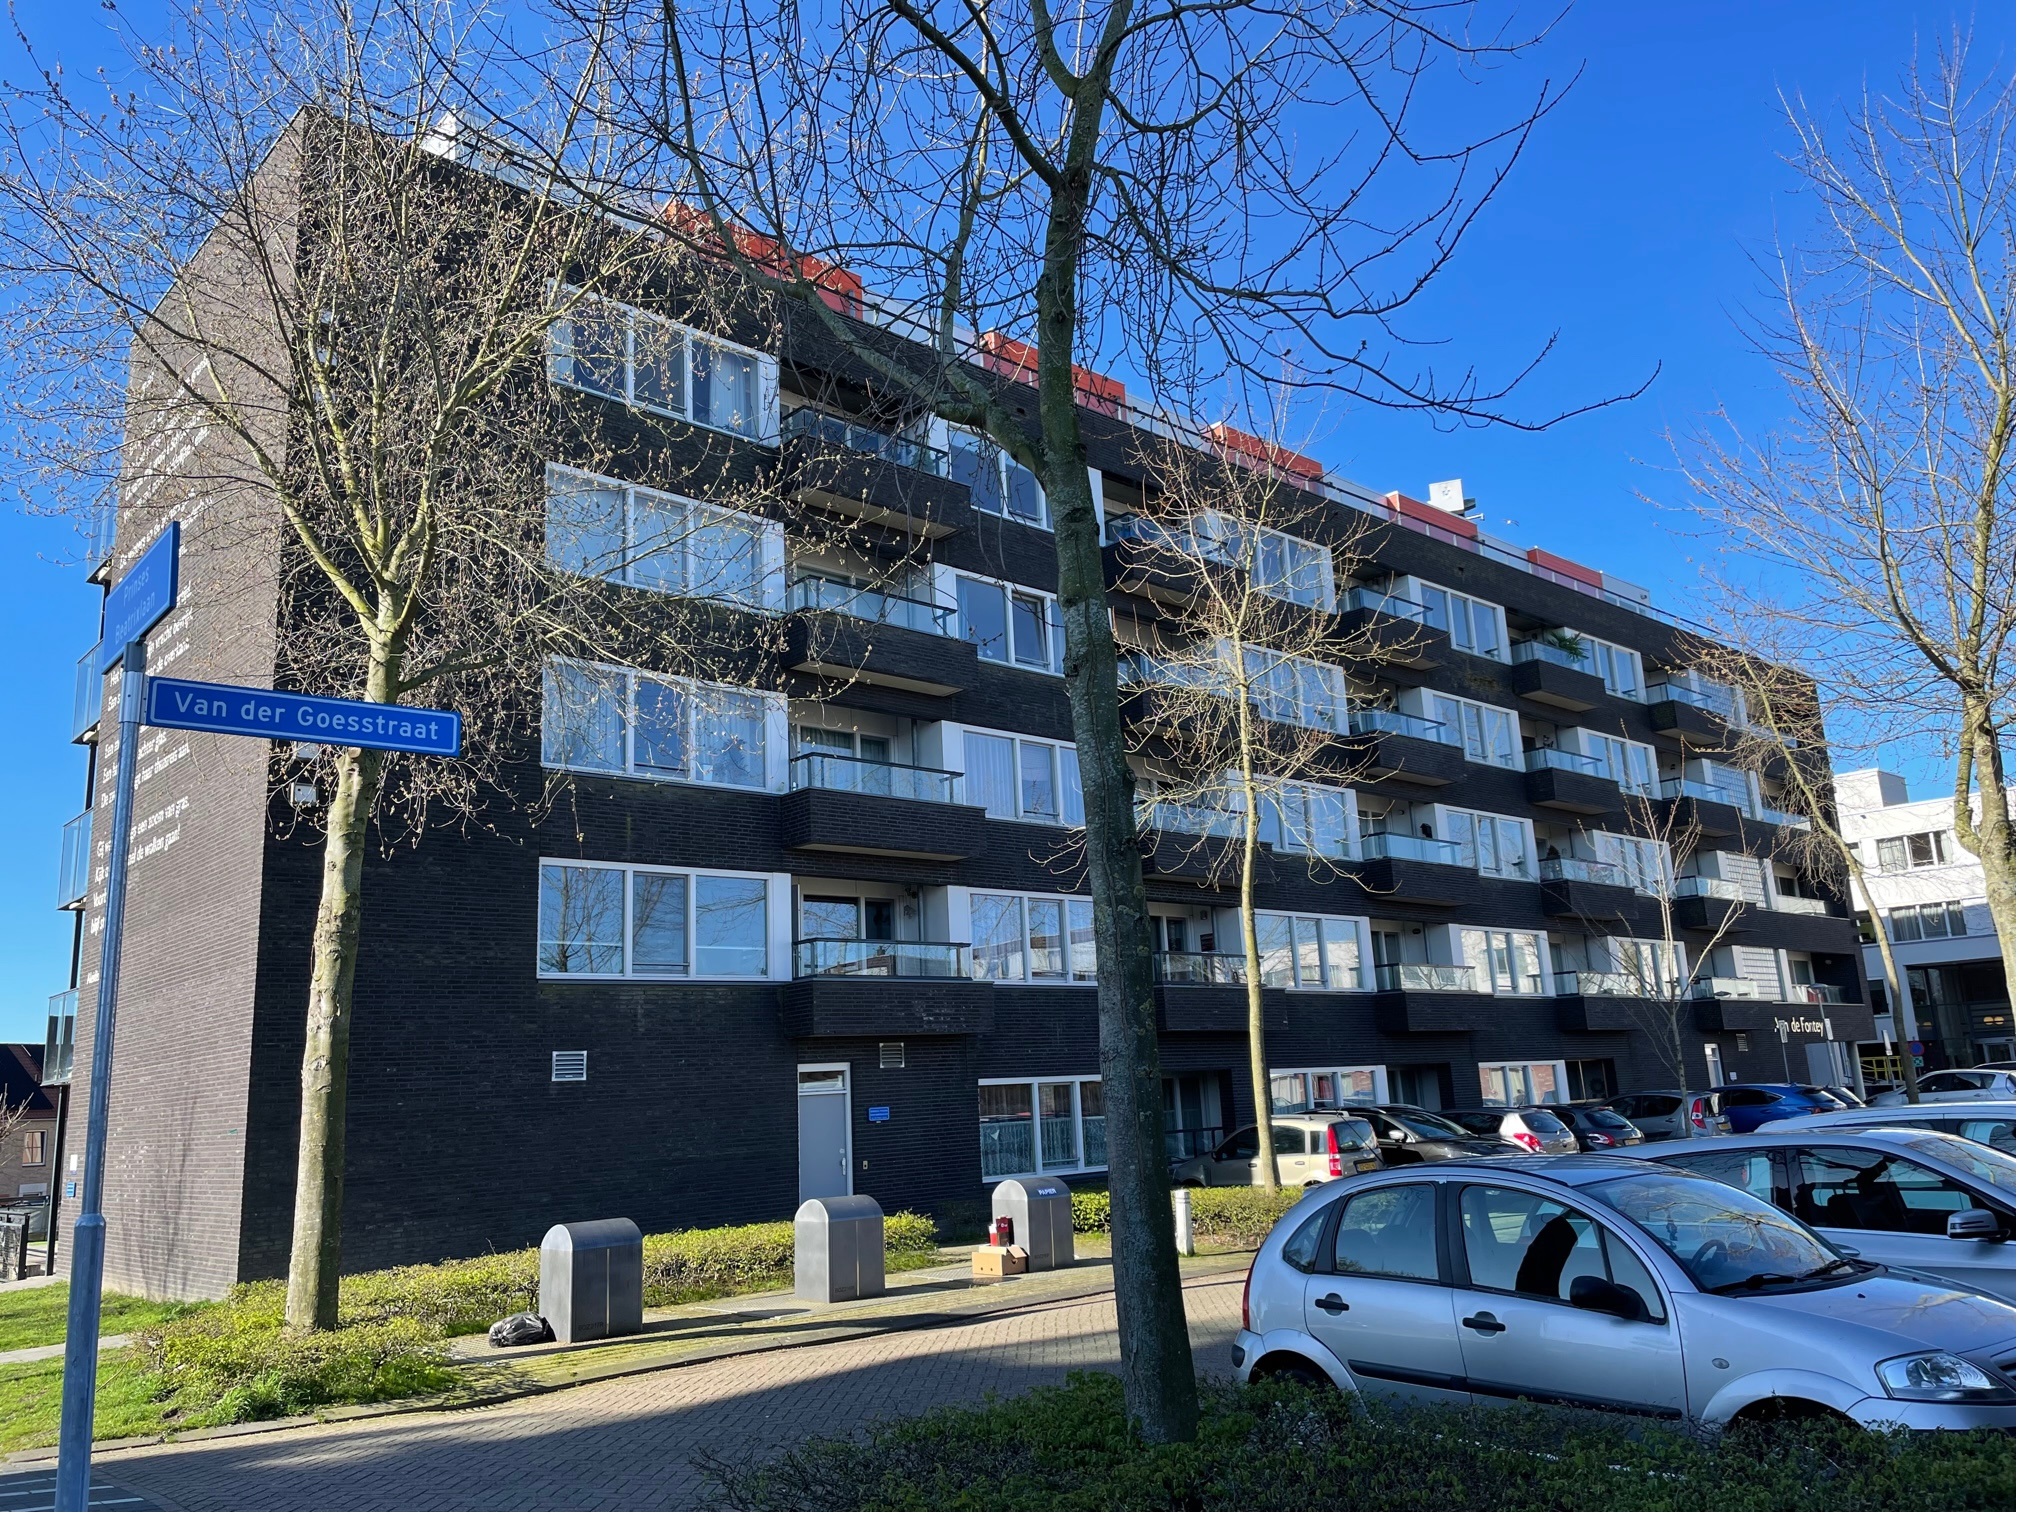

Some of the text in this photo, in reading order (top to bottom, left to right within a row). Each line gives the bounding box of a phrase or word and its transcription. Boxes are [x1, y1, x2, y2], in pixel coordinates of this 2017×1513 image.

[123, 565, 150, 607] Prinses
[115, 591, 156, 645] Beatrixlaan
[174, 691, 439, 740] Van der Goesstraat
[1036, 1187, 1057, 1196] PAPIER
